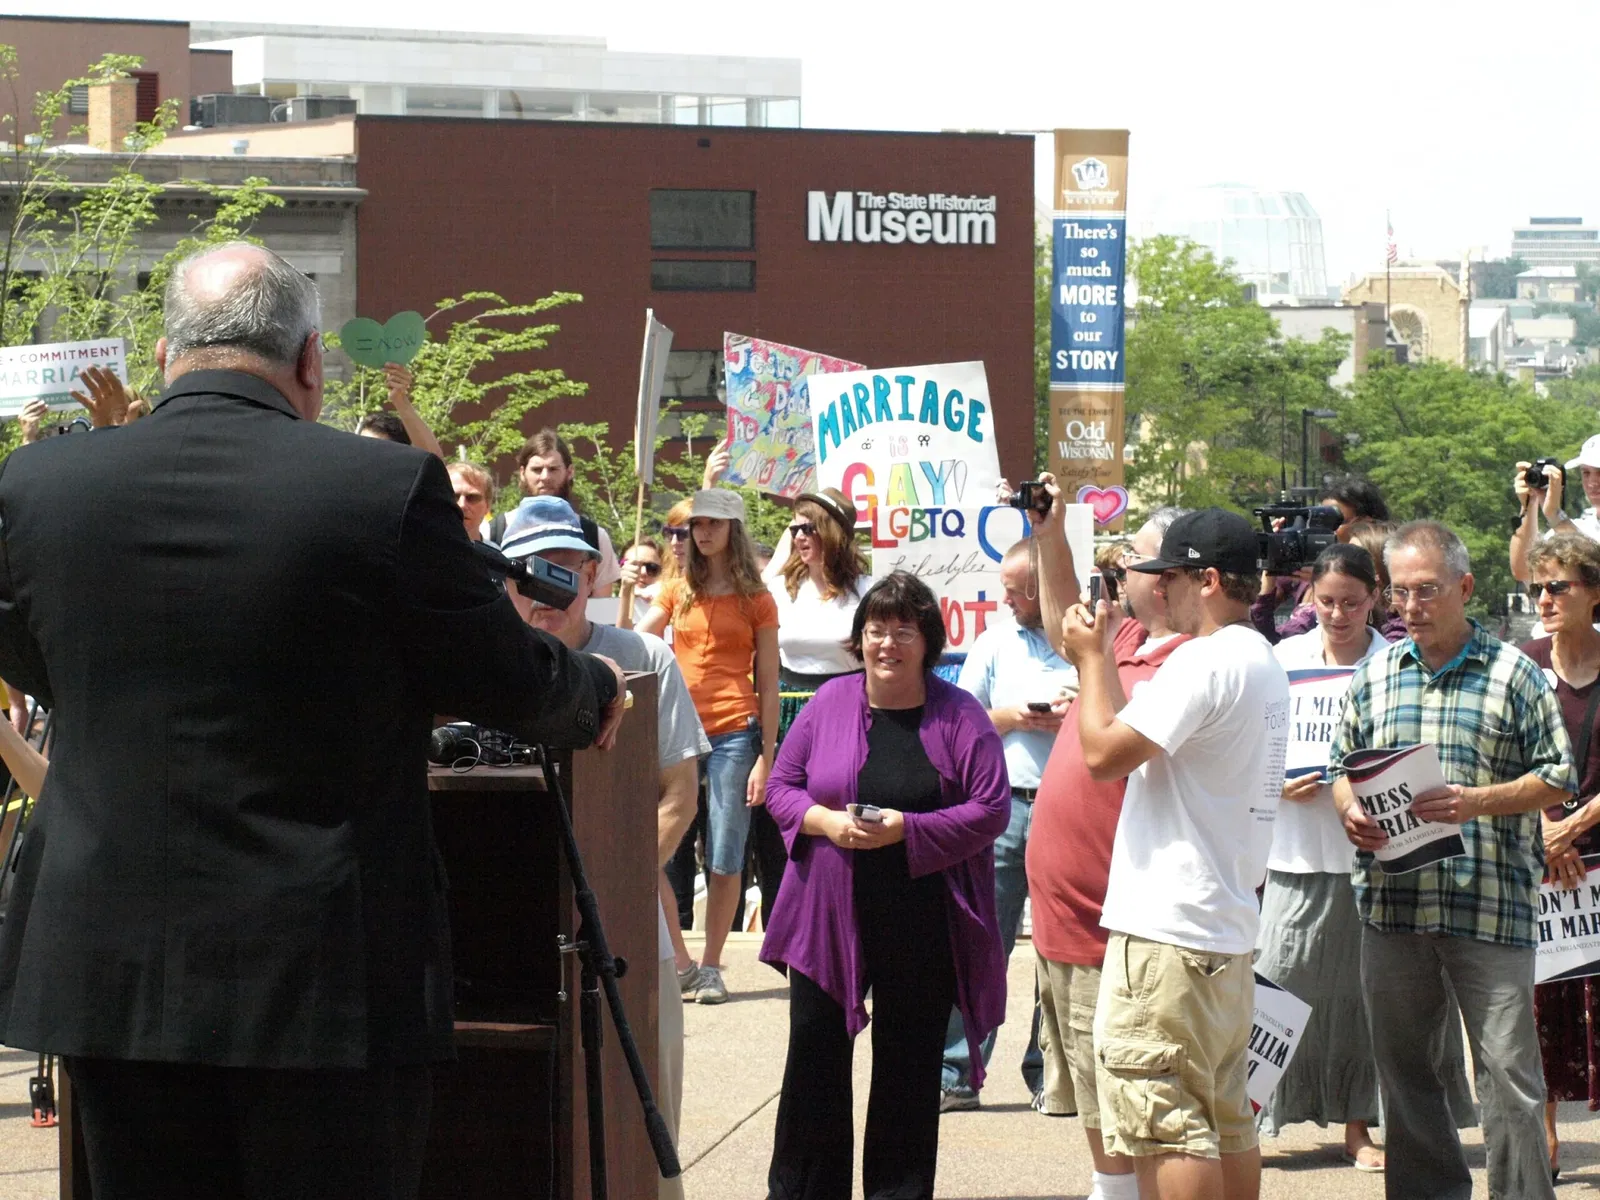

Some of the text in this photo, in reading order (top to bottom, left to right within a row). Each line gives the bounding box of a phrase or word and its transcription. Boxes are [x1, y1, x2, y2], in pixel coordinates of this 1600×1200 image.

[857, 191, 997, 212] The State Historical
[807, 191, 997, 244] Museum
[1062, 222, 1118, 240] There's
[1080, 247, 1098, 258] so
[1066, 261, 1112, 277] much
[1060, 284, 1118, 305] MORE
[1080, 310, 1097, 323] to
[1073, 329, 1103, 342] our
[20, 346, 119, 363] COMMITMENT
[728, 342, 795, 380] Jesus
[1056, 349, 1119, 370] STORY
[733, 414, 759, 442] he
[818, 374, 986, 465] MARRIAGE
[1066, 420, 1106, 441] Odd
[1058, 441, 1115, 461] WISCONSIN
[870, 507, 966, 548] LGBTQ
[1357, 782, 1414, 816] MESS
[1376, 808, 1431, 839] RIA
